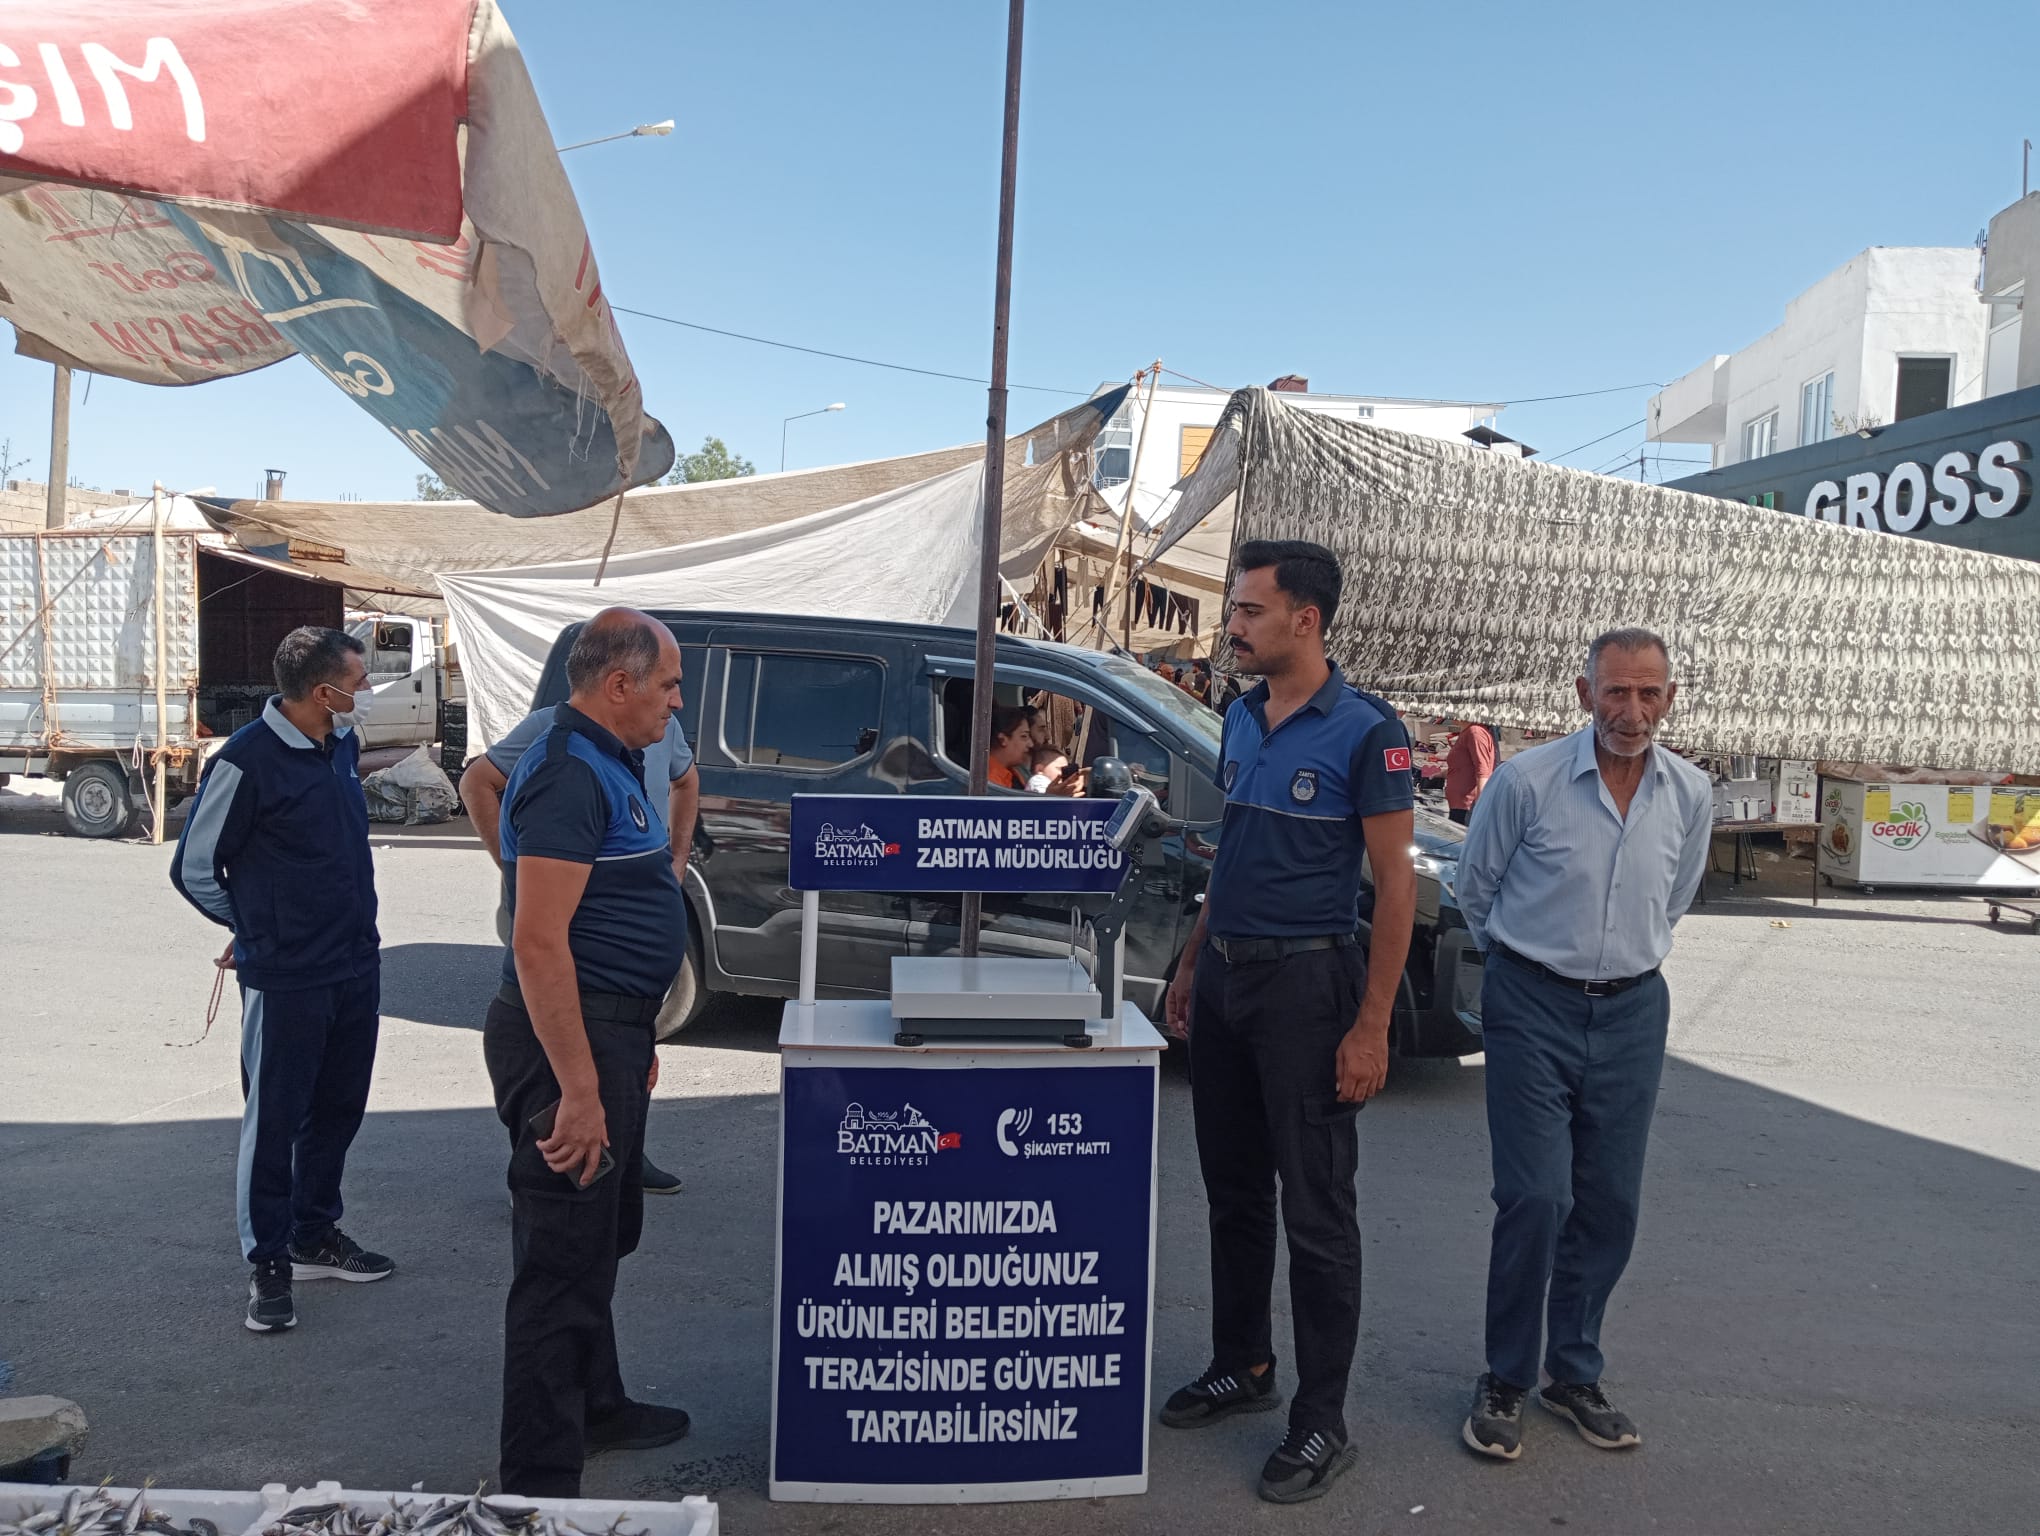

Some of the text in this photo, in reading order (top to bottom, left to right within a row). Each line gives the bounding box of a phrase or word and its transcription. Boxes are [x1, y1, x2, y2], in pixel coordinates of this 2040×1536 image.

[1804, 440, 2024, 532] GROSS
[918, 815, 1107, 841] BATMAN BELEDİYE
[1872, 821, 1922, 837] Gedik
[814, 842, 886, 859] BATMAN
[823, 857, 878, 866] BELEDİYESİ
[917, 847, 990, 869] ZABITA
[1047, 1113, 1082, 1136] 153
[837, 1130, 940, 1154] BATMAN
[1024, 1140, 1110, 1159] ŞİKAYET HATTI
[850, 1155, 929, 1166] BELEDİYESİ
[873, 1200, 1057, 1234] PAZARIMIZDA
[834, 1245, 1099, 1296] ALMIŞ OLDUĞUNUZ
[797, 1295, 1125, 1340] ÜRÜNLERİ BELEDİYEMİZ
[804, 1350, 1121, 1391] TERAZİSİNDE GÜVENLE
[847, 1400, 1078, 1443] TARTABİLİRSİNİZ
